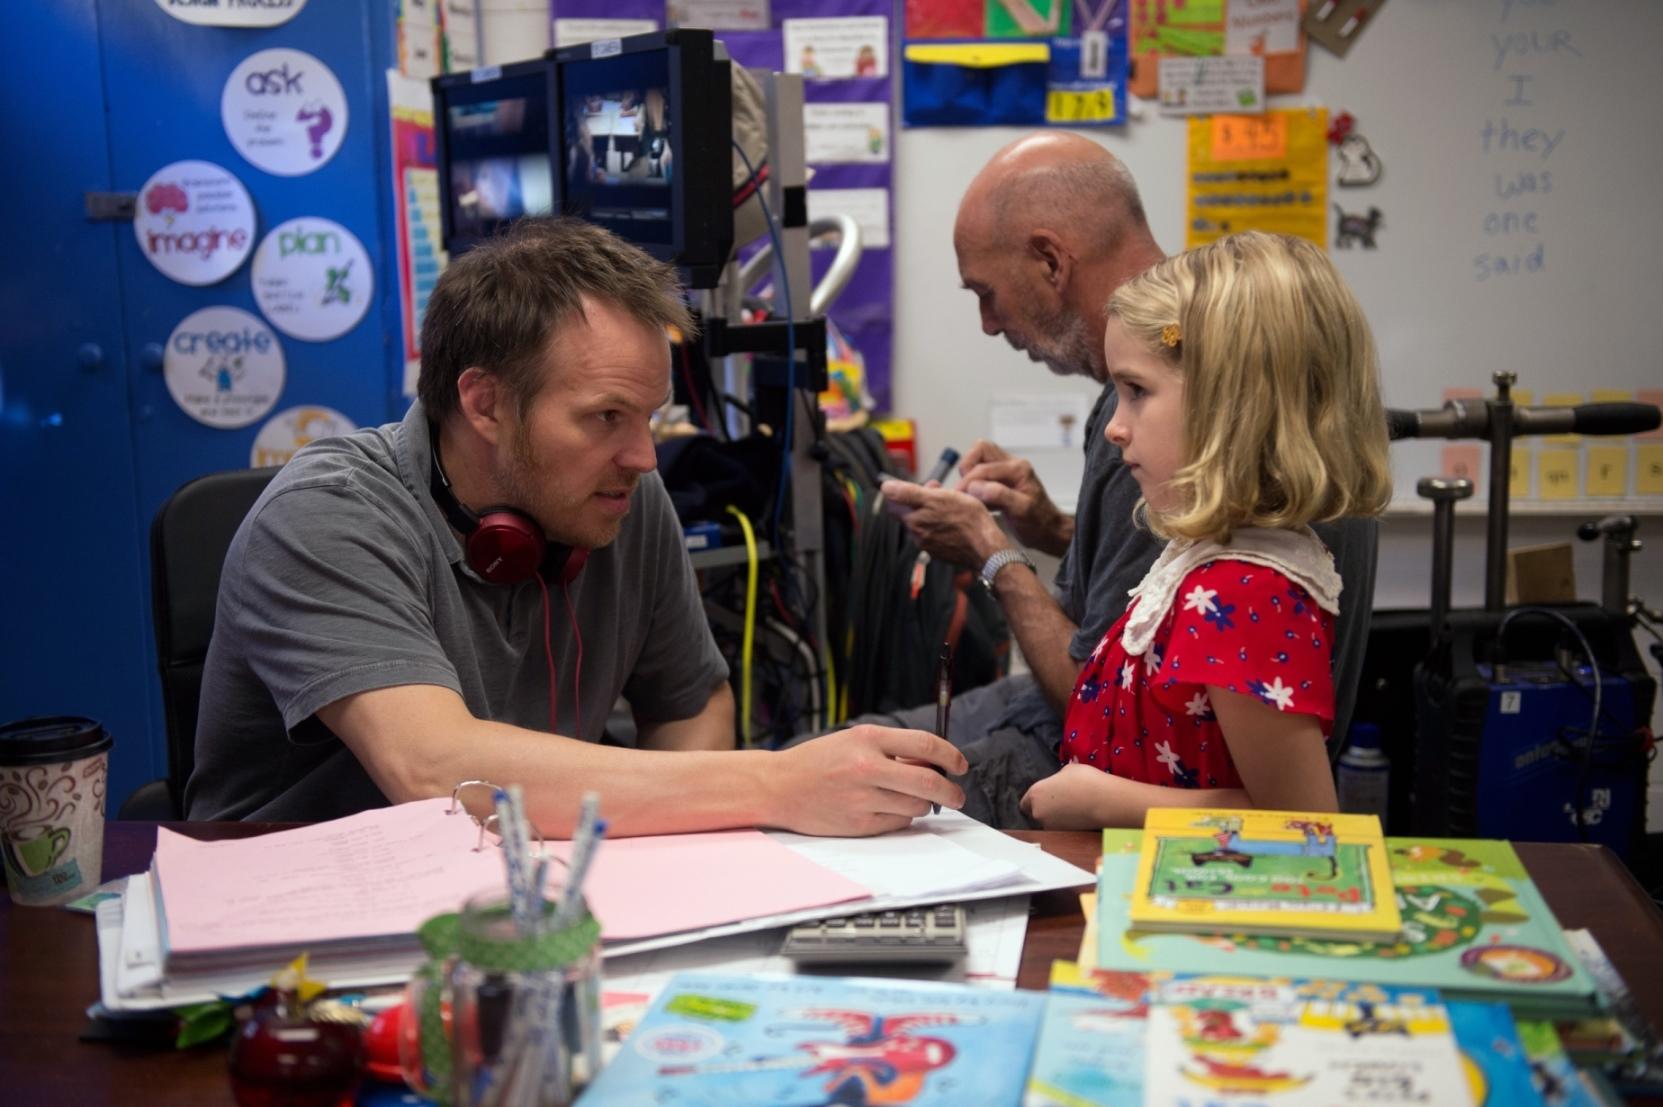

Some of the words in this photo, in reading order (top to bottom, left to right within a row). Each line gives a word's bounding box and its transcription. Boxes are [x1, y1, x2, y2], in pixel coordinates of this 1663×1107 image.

[245, 63, 304, 95] ask
[1480, 117, 1566, 159] they
[1495, 171, 1552, 199] was
[1483, 211, 1538, 235] one
[146, 227, 247, 262] imagine
[278, 225, 342, 260] plan
[1472, 242, 1545, 283] said
[174, 326, 272, 355] create
